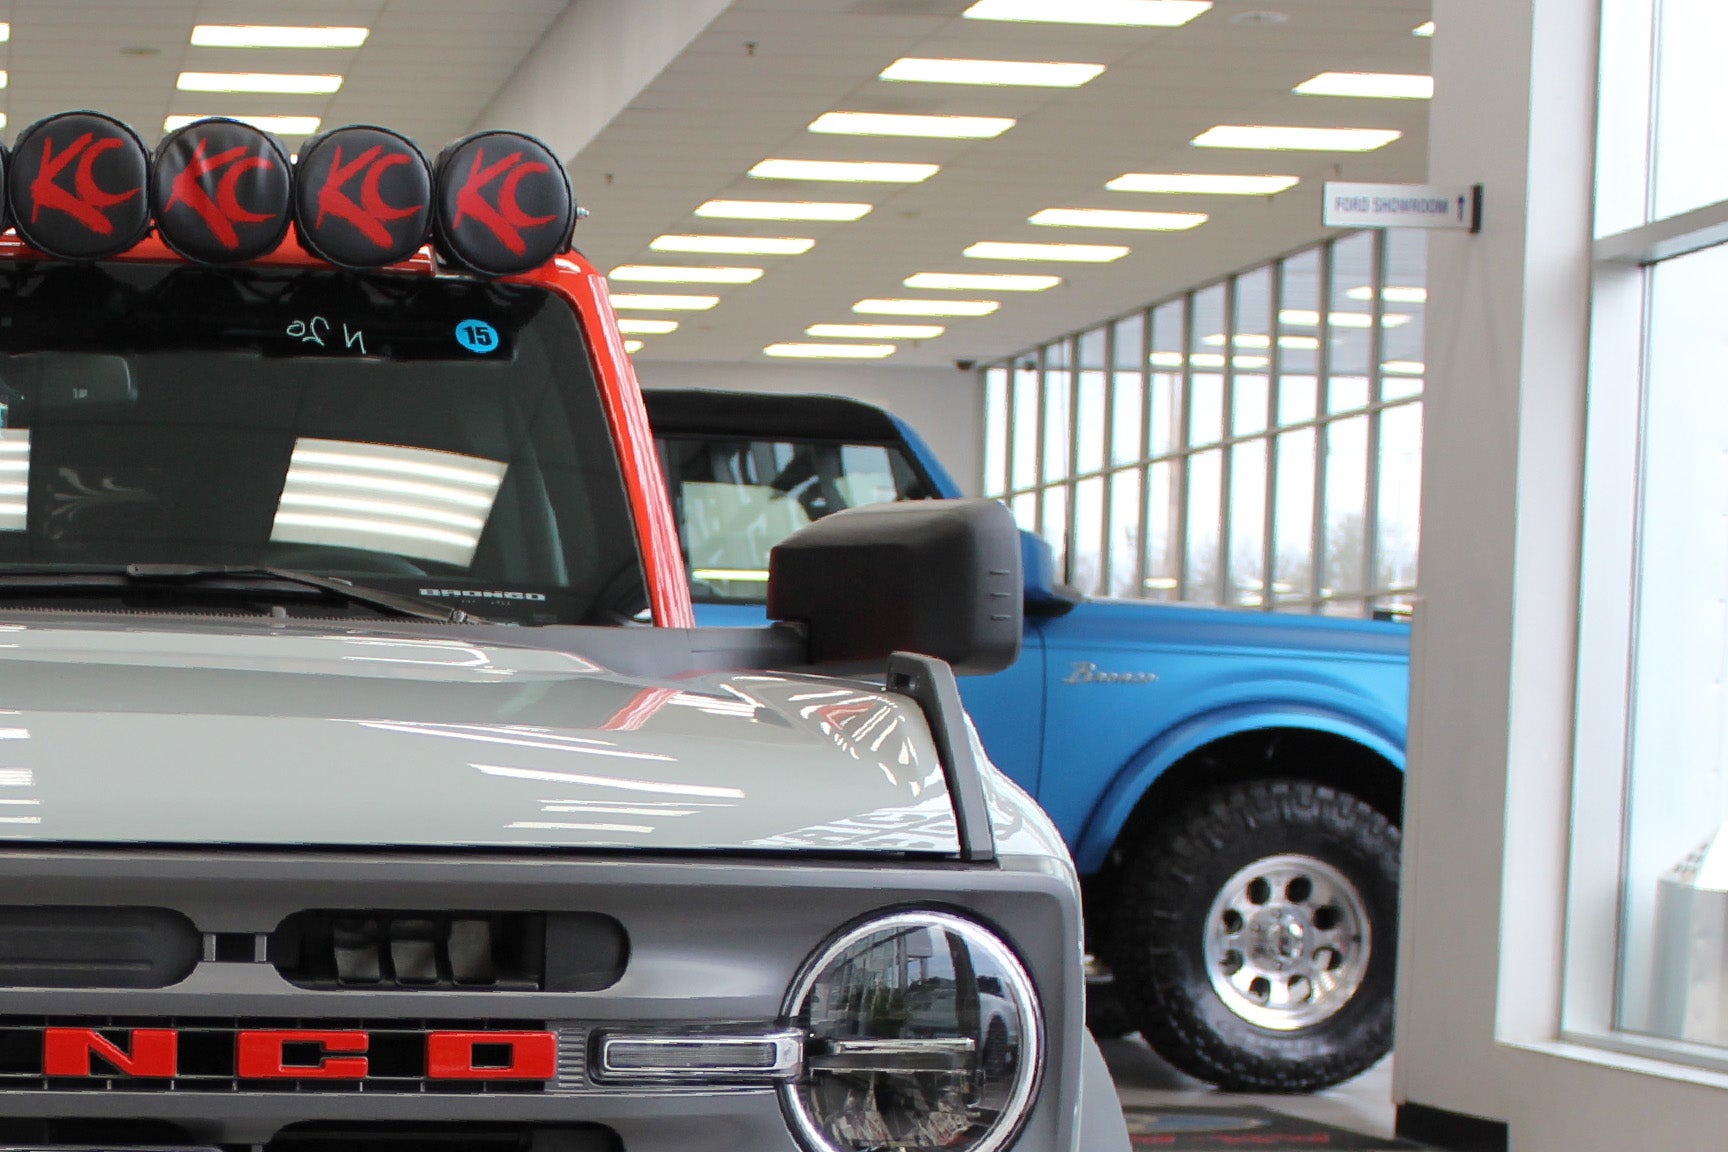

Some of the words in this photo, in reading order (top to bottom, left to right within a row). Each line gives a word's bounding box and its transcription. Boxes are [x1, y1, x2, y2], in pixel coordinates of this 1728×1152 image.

[31, 132, 143, 236] KC
[164, 137, 276, 249] KC
[315, 144, 424, 251] KC
[453, 147, 557, 257] KC
[1335, 196, 1369, 212] FORD
[1373, 197, 1449, 213] SHOWROOM
[464, 325, 491, 346] 15
[419, 588, 546, 601] BRONCO
